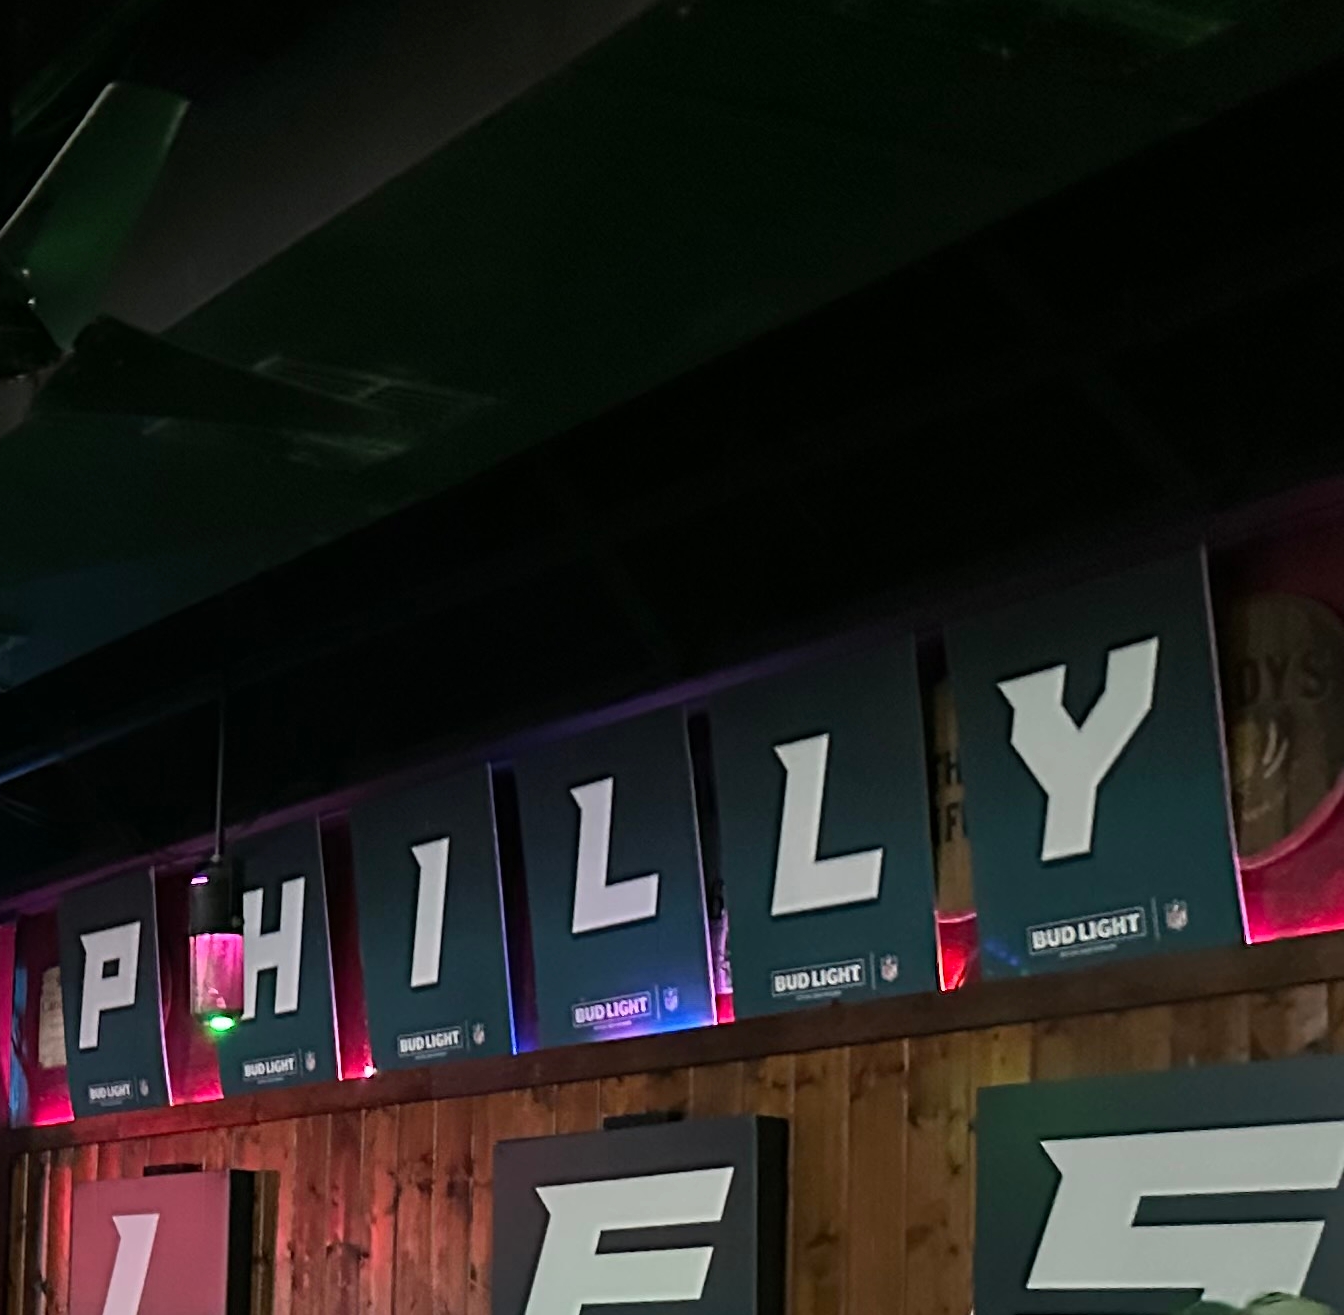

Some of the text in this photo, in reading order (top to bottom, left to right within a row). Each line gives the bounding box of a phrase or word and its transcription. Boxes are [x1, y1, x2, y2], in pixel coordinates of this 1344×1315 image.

[1032, 925, 1077, 951] BUD
[1079, 912, 1140, 942] LIGHT
[774, 964, 861, 993] BUD LIGHT
[575, 1005, 604, 1025] BUD
[606, 998, 647, 1018] LIGHT
[400, 1030, 460, 1053] BUD LIGHT
[244, 1057, 295, 1077] BUD LIGHT
[89, 1083, 131, 1100] BUD LIGHT
